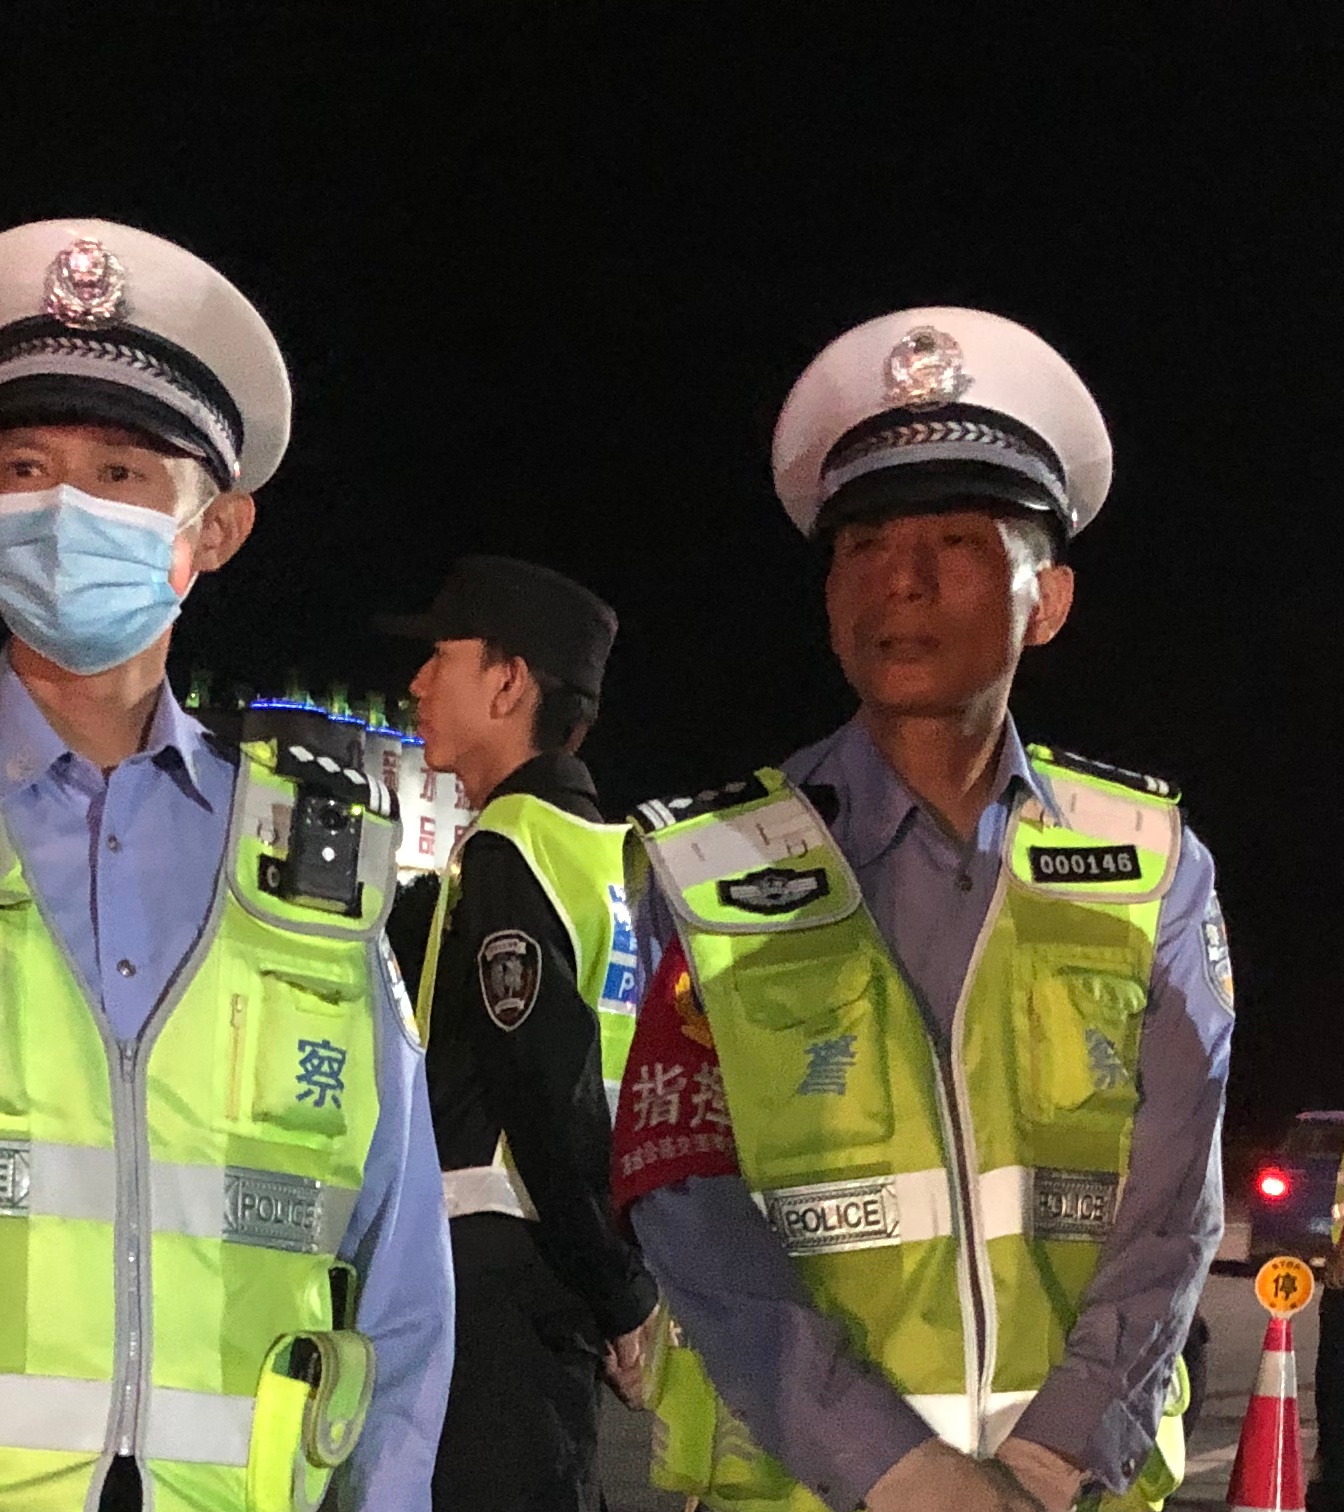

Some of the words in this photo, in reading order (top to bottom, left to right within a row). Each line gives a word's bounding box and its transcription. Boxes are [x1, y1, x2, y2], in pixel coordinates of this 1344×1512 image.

[1039, 852, 1133, 875] 000146
[294, 1038, 347, 1110] 察
[241, 1193, 316, 1229] POLICE
[785, 1198, 881, 1233] POLICE
[1038, 1191, 1105, 1221] POLICE
